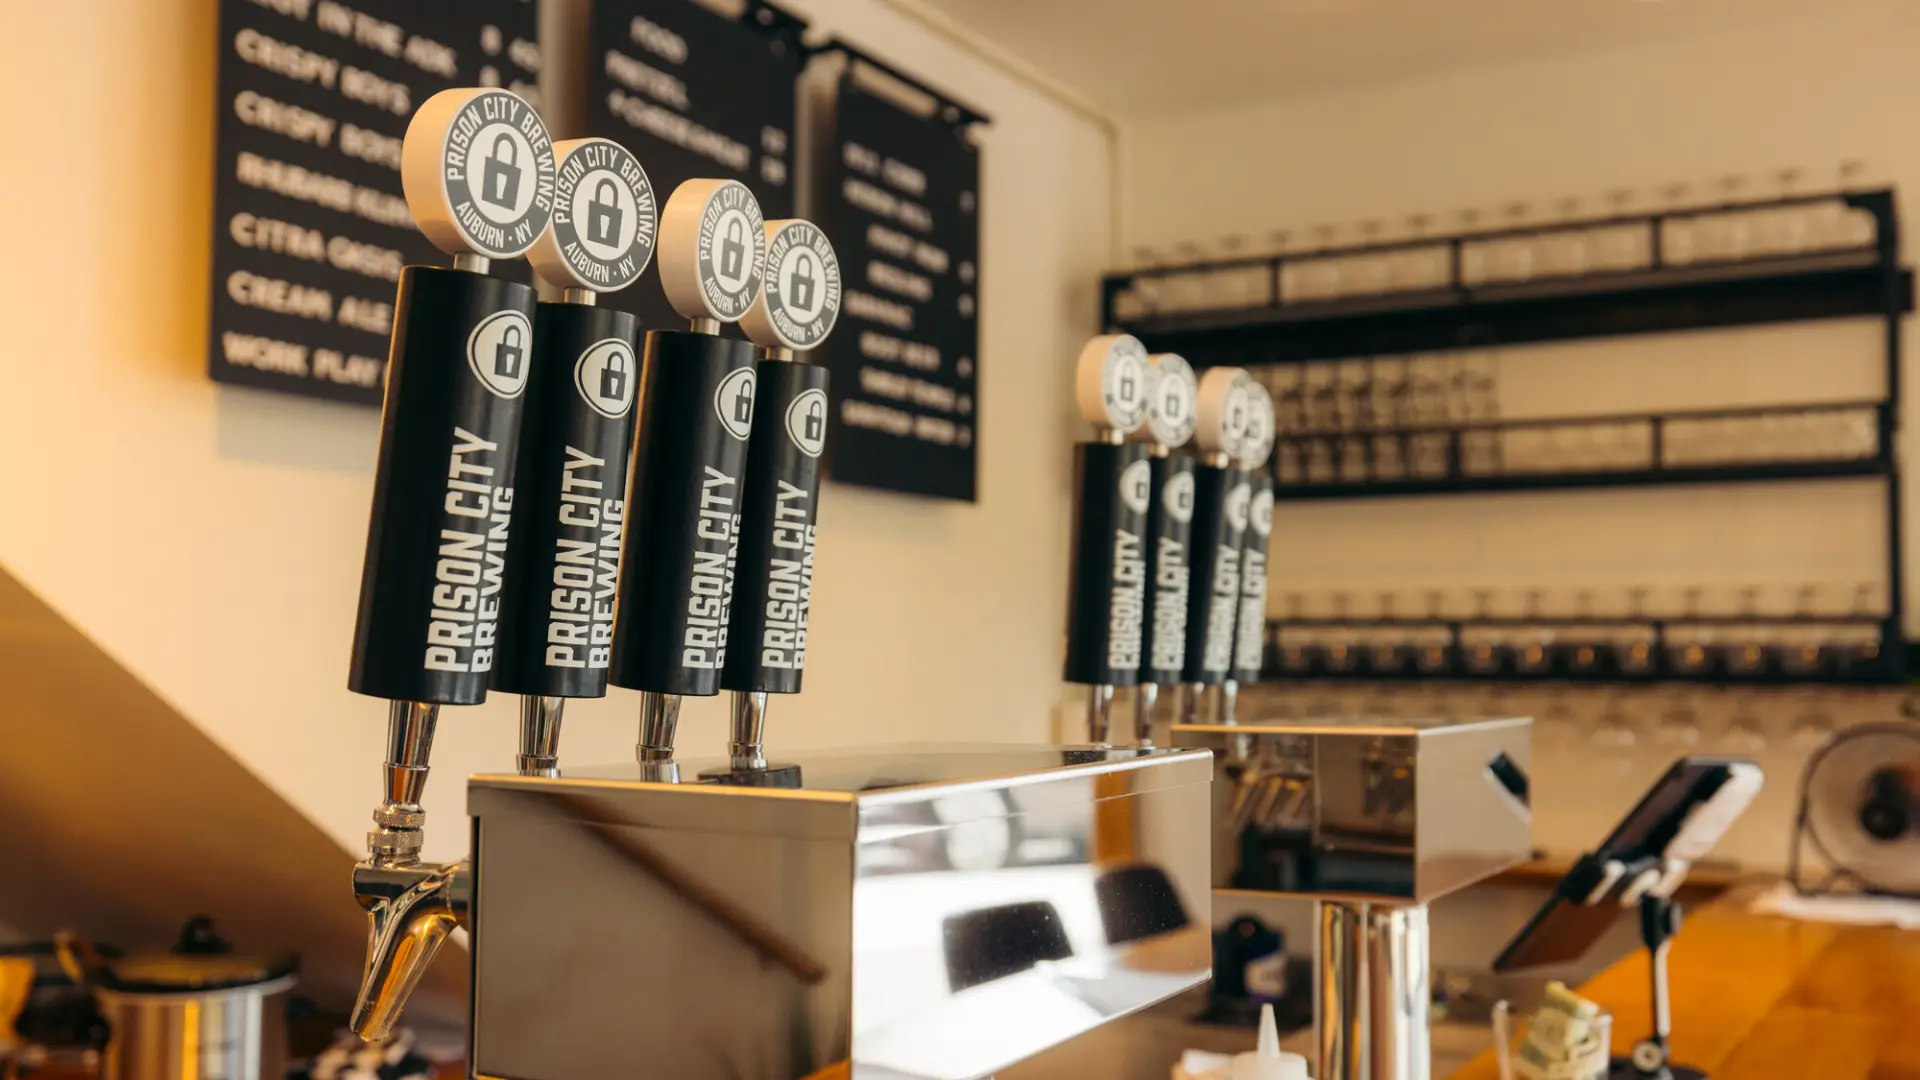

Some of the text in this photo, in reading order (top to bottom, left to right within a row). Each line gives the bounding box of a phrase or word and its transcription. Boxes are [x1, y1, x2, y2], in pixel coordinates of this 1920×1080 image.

[447, 105, 483, 180] PRISON
[483, 97, 520, 122] CITY
[520, 111, 554, 213] BREWING
[555, 146, 653, 248] PRISON CITY BREWING
[456, 201, 504, 248] AUBURN
[515, 219, 533, 245] NY
[564, 241, 636, 283] AUBURN NY
[700, 187, 765, 280] PRISON CITY BREWING
[766, 235, 789, 294] PRISON
[789, 225, 813, 245] CITY
[813, 233, 838, 312] BREWING
[226, 269, 393, 336] CREAM ALE
[704, 277, 750, 314] AUBURN NY
[772, 307, 825, 342] AUBURN NY
[222, 330, 309, 378] WORK
[424, 426, 498, 673] PRISON CITY
[471, 486, 514, 673] BREWING
[545, 445, 605, 668] PRISON CITY
[588, 499, 624, 669] BREWING
[682, 465, 735, 669] PRISON CITY
[761, 480, 808, 669] PRISON CITY
[1112, 528, 1140, 584] CITY
[1156, 536, 1184, 588] CITY
